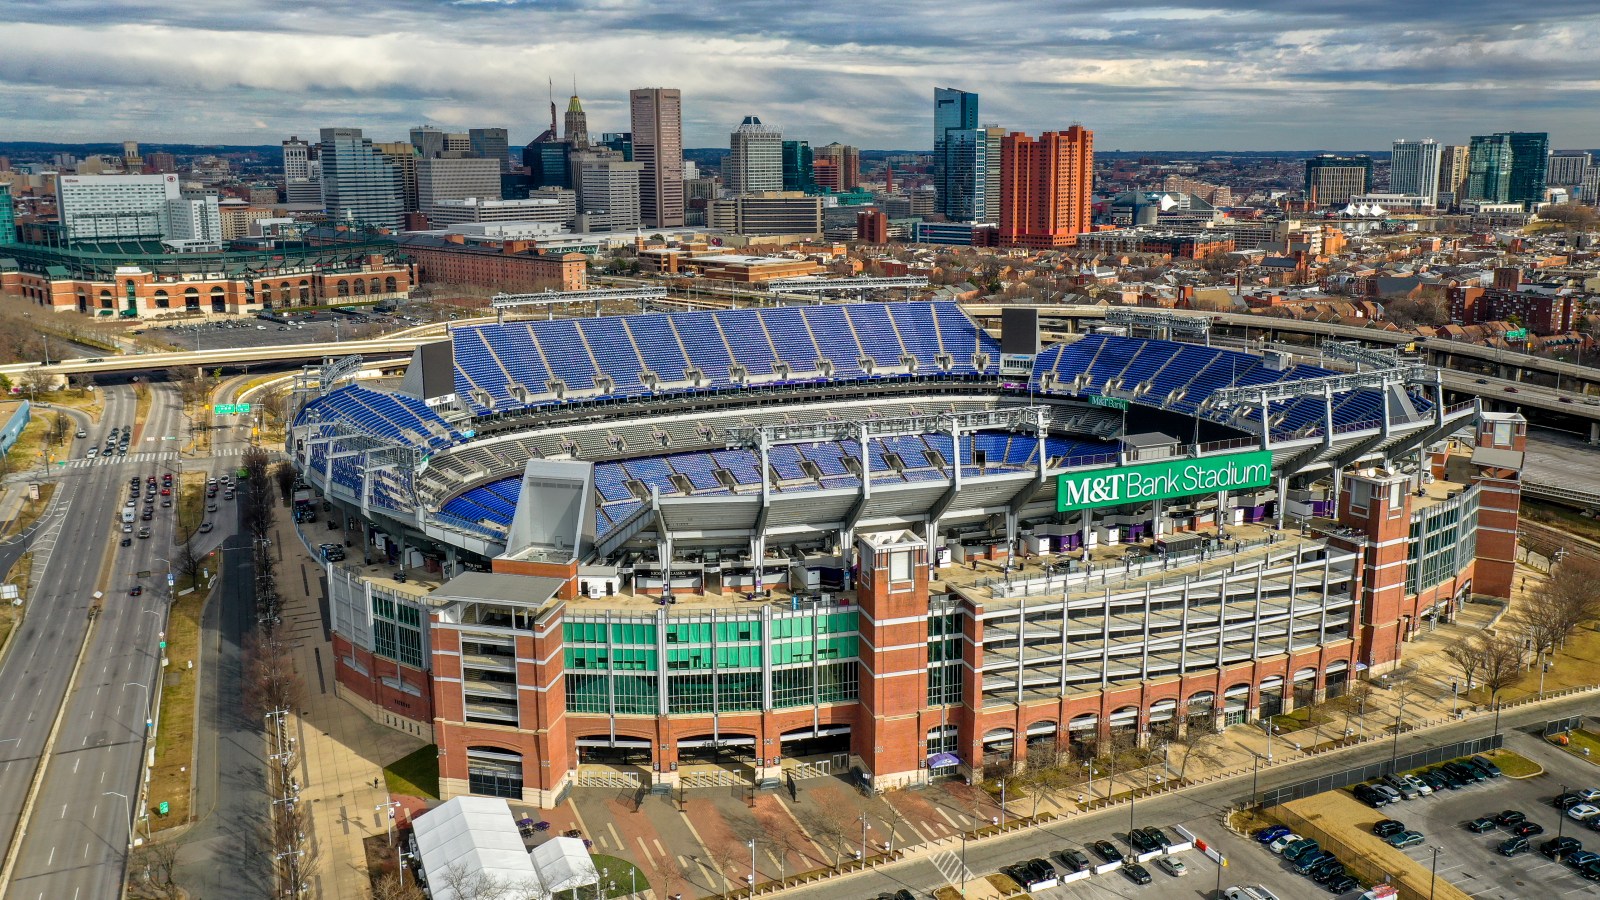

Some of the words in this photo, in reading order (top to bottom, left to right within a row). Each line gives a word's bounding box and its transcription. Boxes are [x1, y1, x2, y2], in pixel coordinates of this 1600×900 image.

[1091, 396, 1108, 407] M&T
[1108, 399, 1126, 410] Bank
[1065, 473, 1125, 506] M&T
[1126, 468, 1180, 499] Bank
[1182, 460, 1267, 492] Stadium
